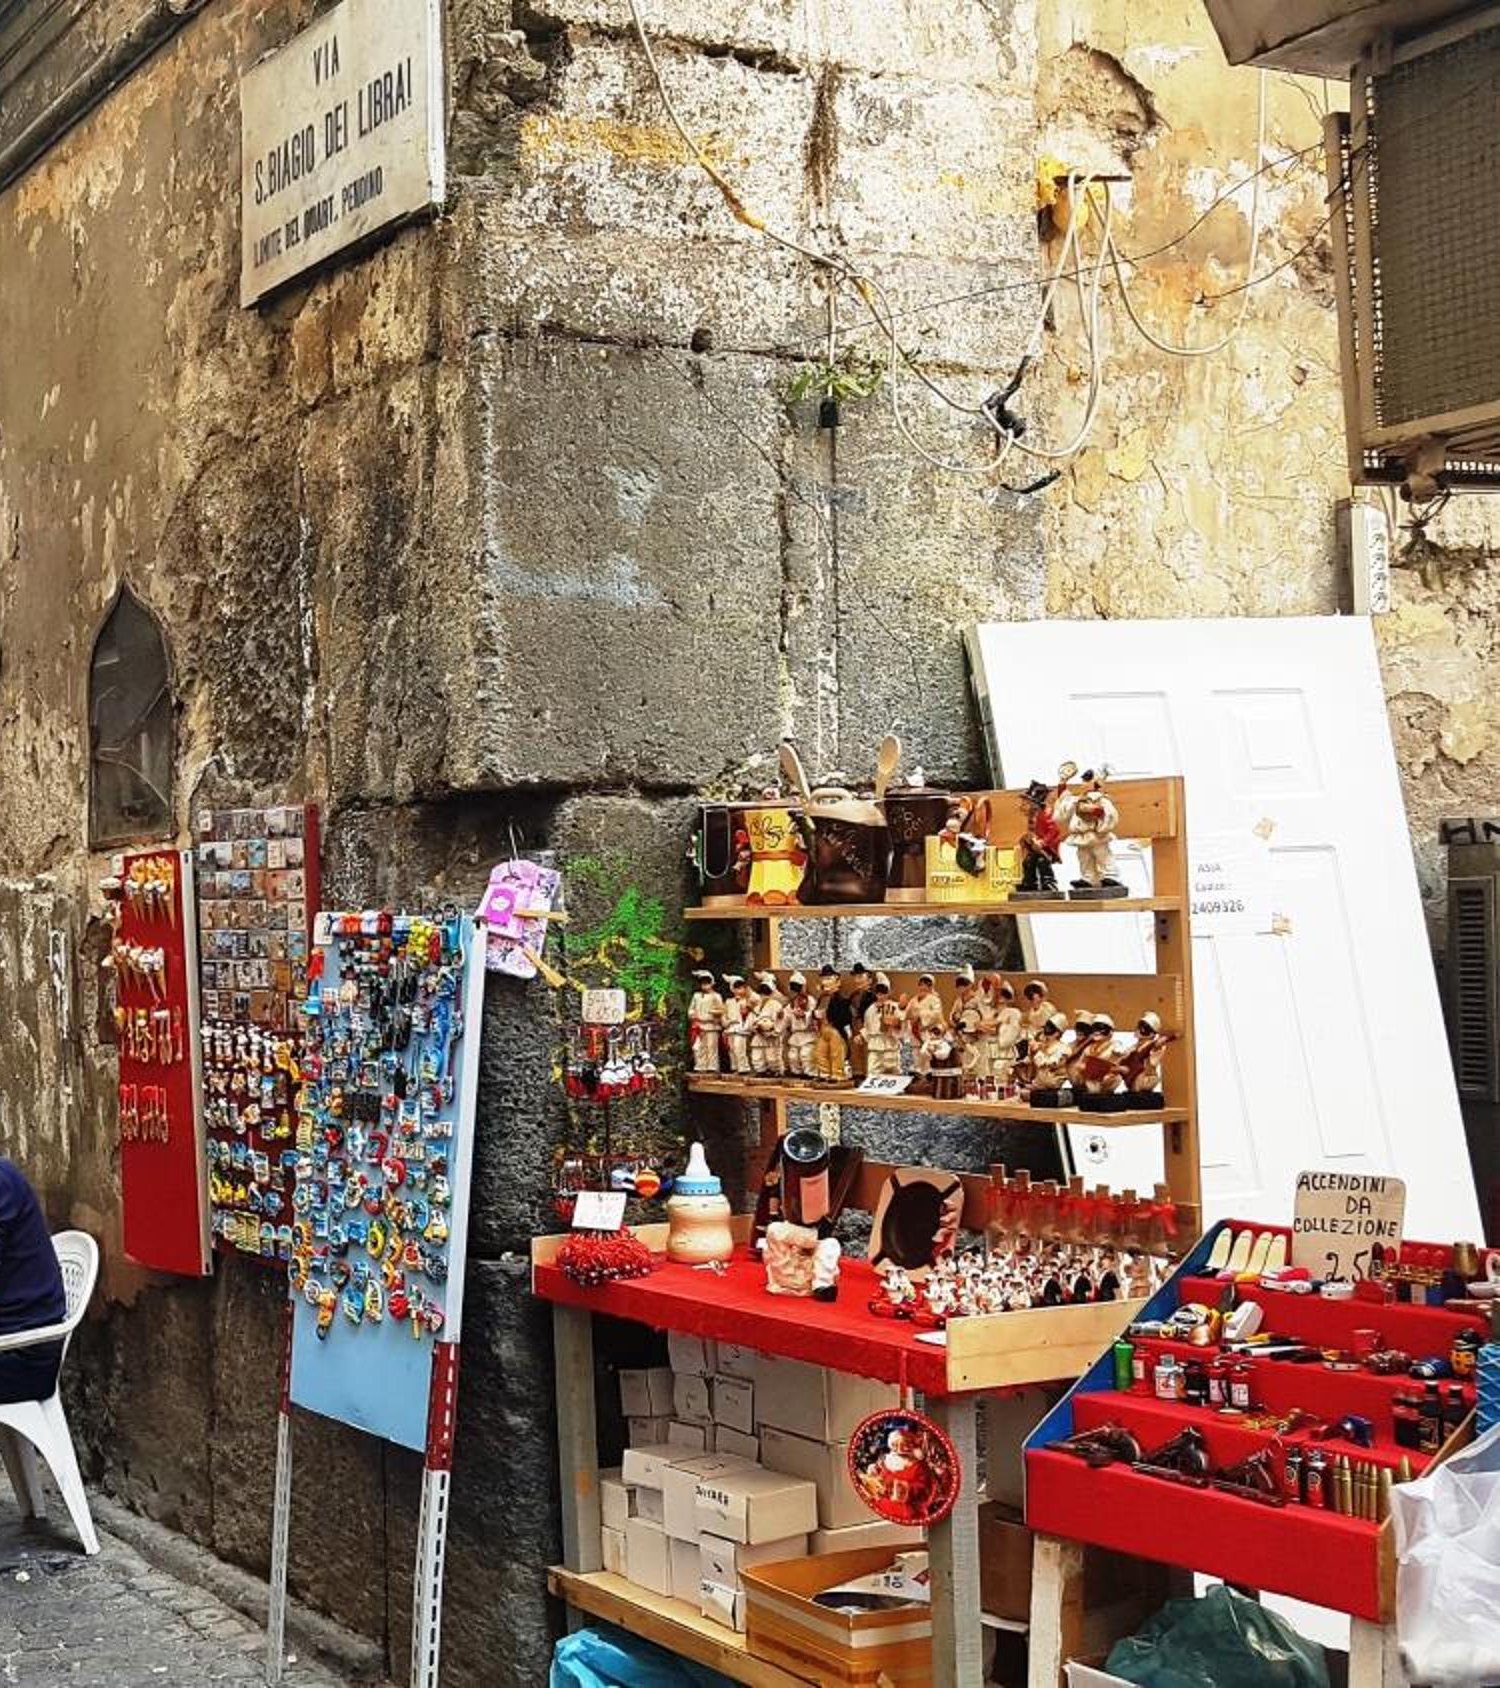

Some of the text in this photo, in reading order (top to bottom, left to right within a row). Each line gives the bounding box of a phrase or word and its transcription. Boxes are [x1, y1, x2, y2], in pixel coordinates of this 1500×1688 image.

[313, 35, 340, 86] VIA
[325, 101, 348, 159] DEI
[285, 216, 300, 250] DEL
[1297, 1173, 1386, 1193] ACCENDINI
[1345, 1195, 1372, 1215] DA
[1293, 1216, 1399, 1237] COLLEZIONE
